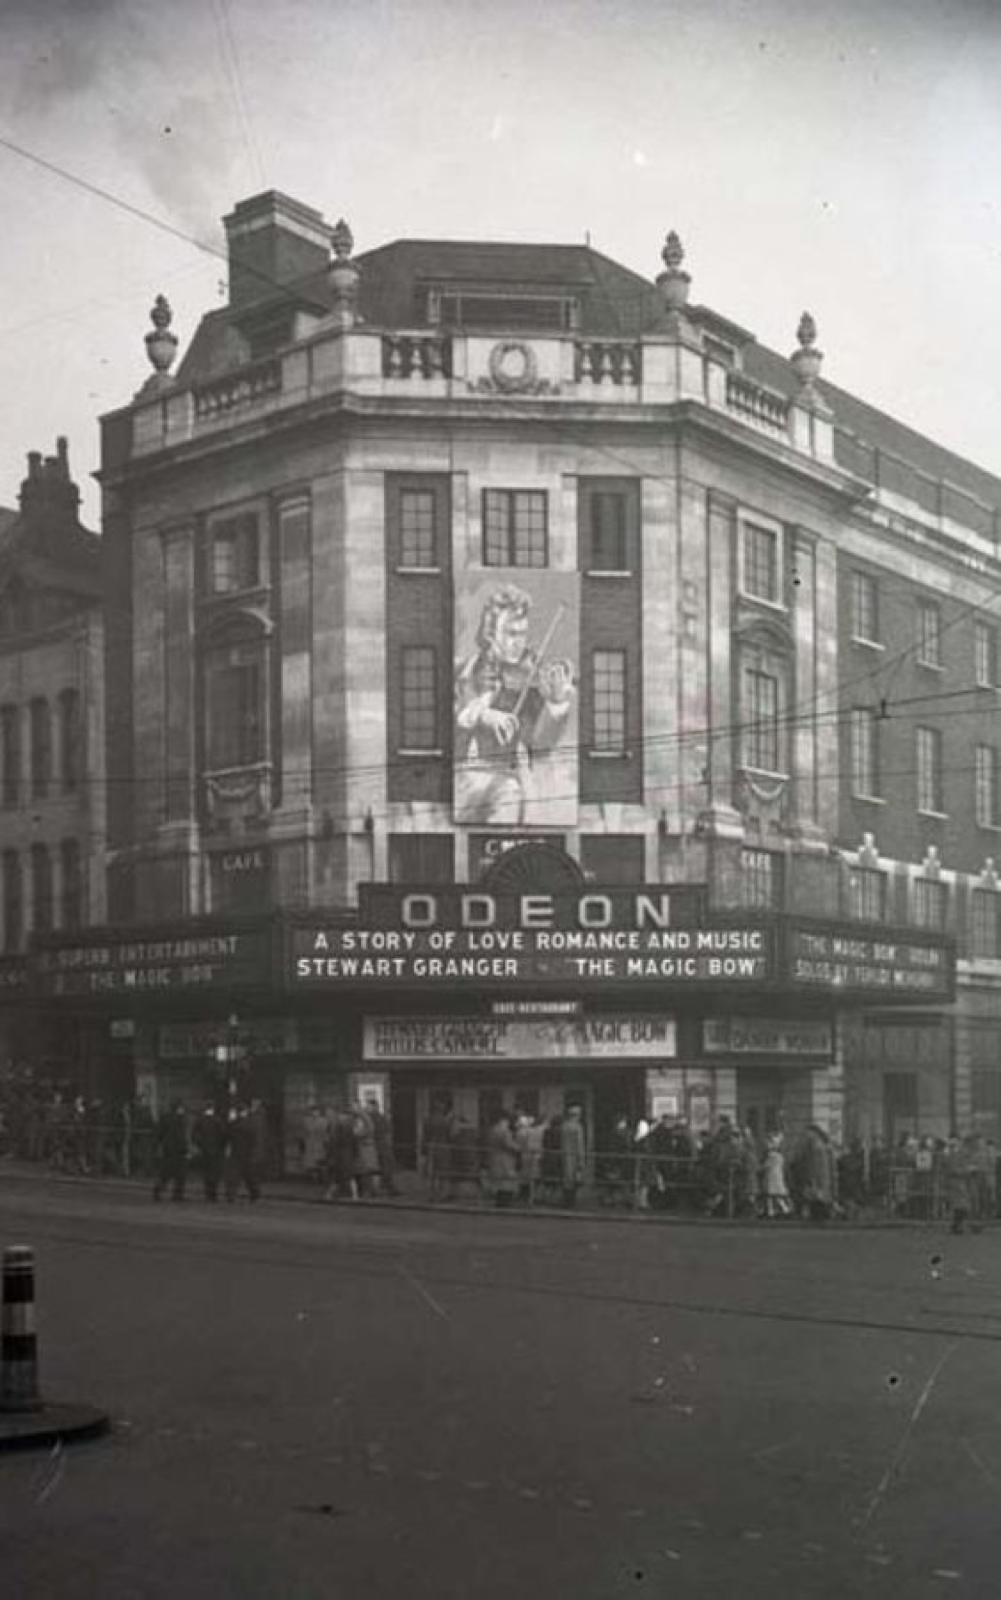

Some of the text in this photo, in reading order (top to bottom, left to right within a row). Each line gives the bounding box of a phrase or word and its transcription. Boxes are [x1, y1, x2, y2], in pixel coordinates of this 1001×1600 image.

[401, 893, 670, 928] ODEON
[314, 931, 762, 950] A STORY OF LOVE ROMANCE AND MUSIC
[296, 957, 406, 977] STEWART
[413, 957, 518, 977] GRANGER
[627, 957, 696, 977] MAGIC
